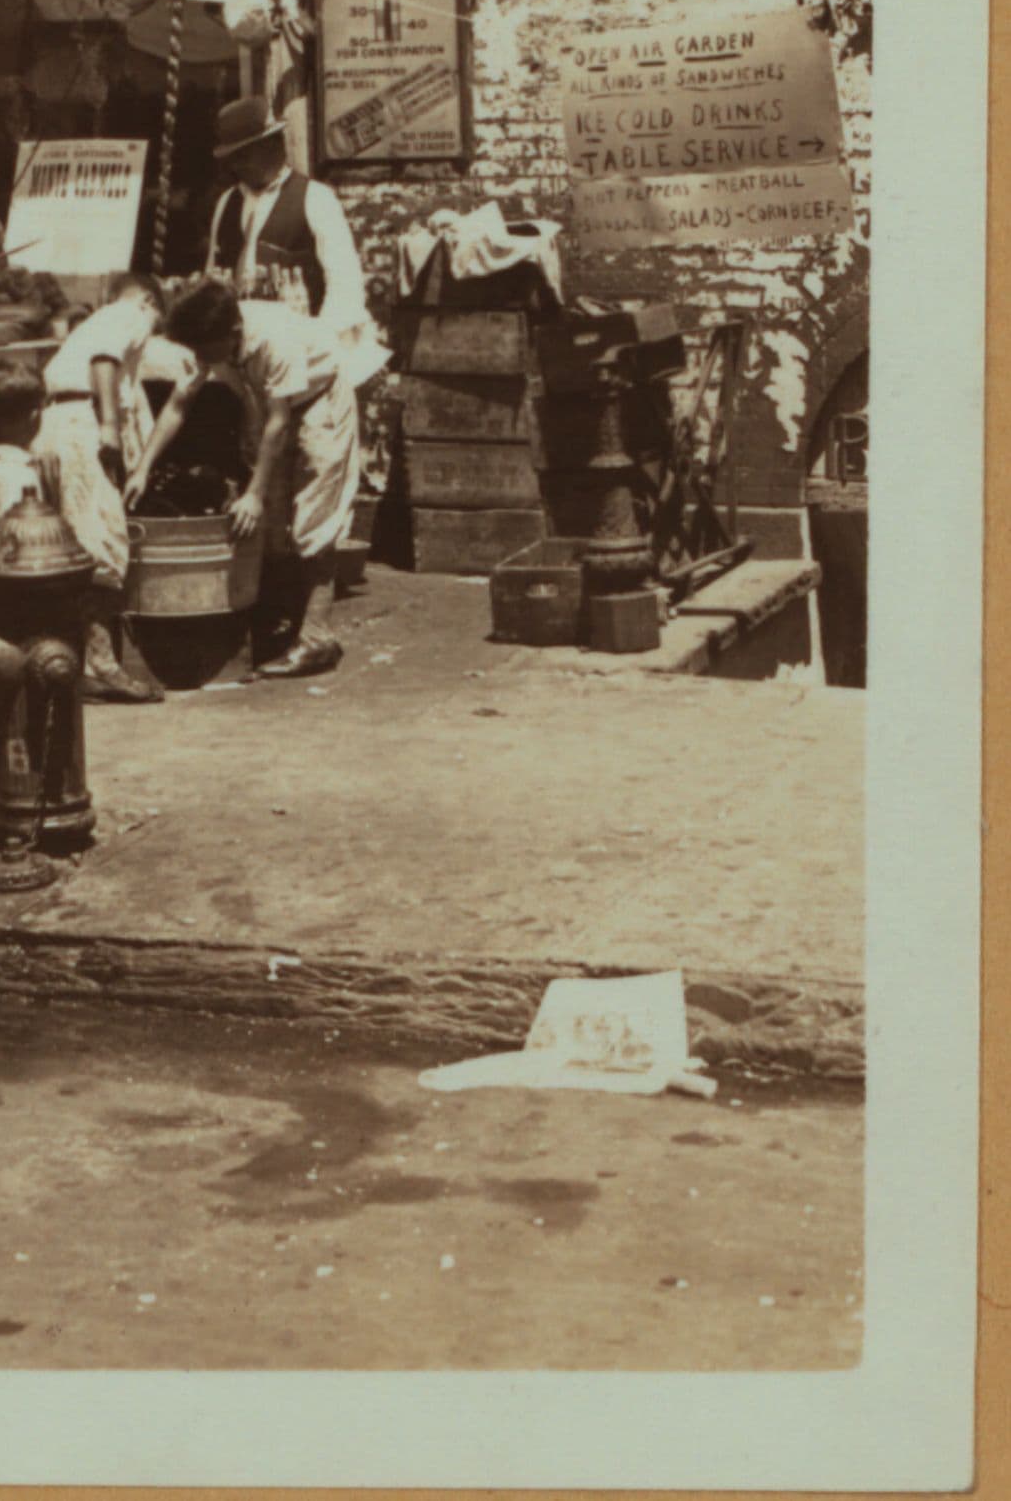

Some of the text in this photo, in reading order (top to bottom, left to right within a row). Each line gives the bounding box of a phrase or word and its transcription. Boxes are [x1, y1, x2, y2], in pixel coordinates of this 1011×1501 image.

[575, 31, 755, 67] OPEN AIR GARDEN
[677, 63, 785, 87] SANDWICHES
[616, 108, 673, 132] COLD
[692, 99, 784, 127] DRINKS
[681, 135, 788, 168] SERVICE
